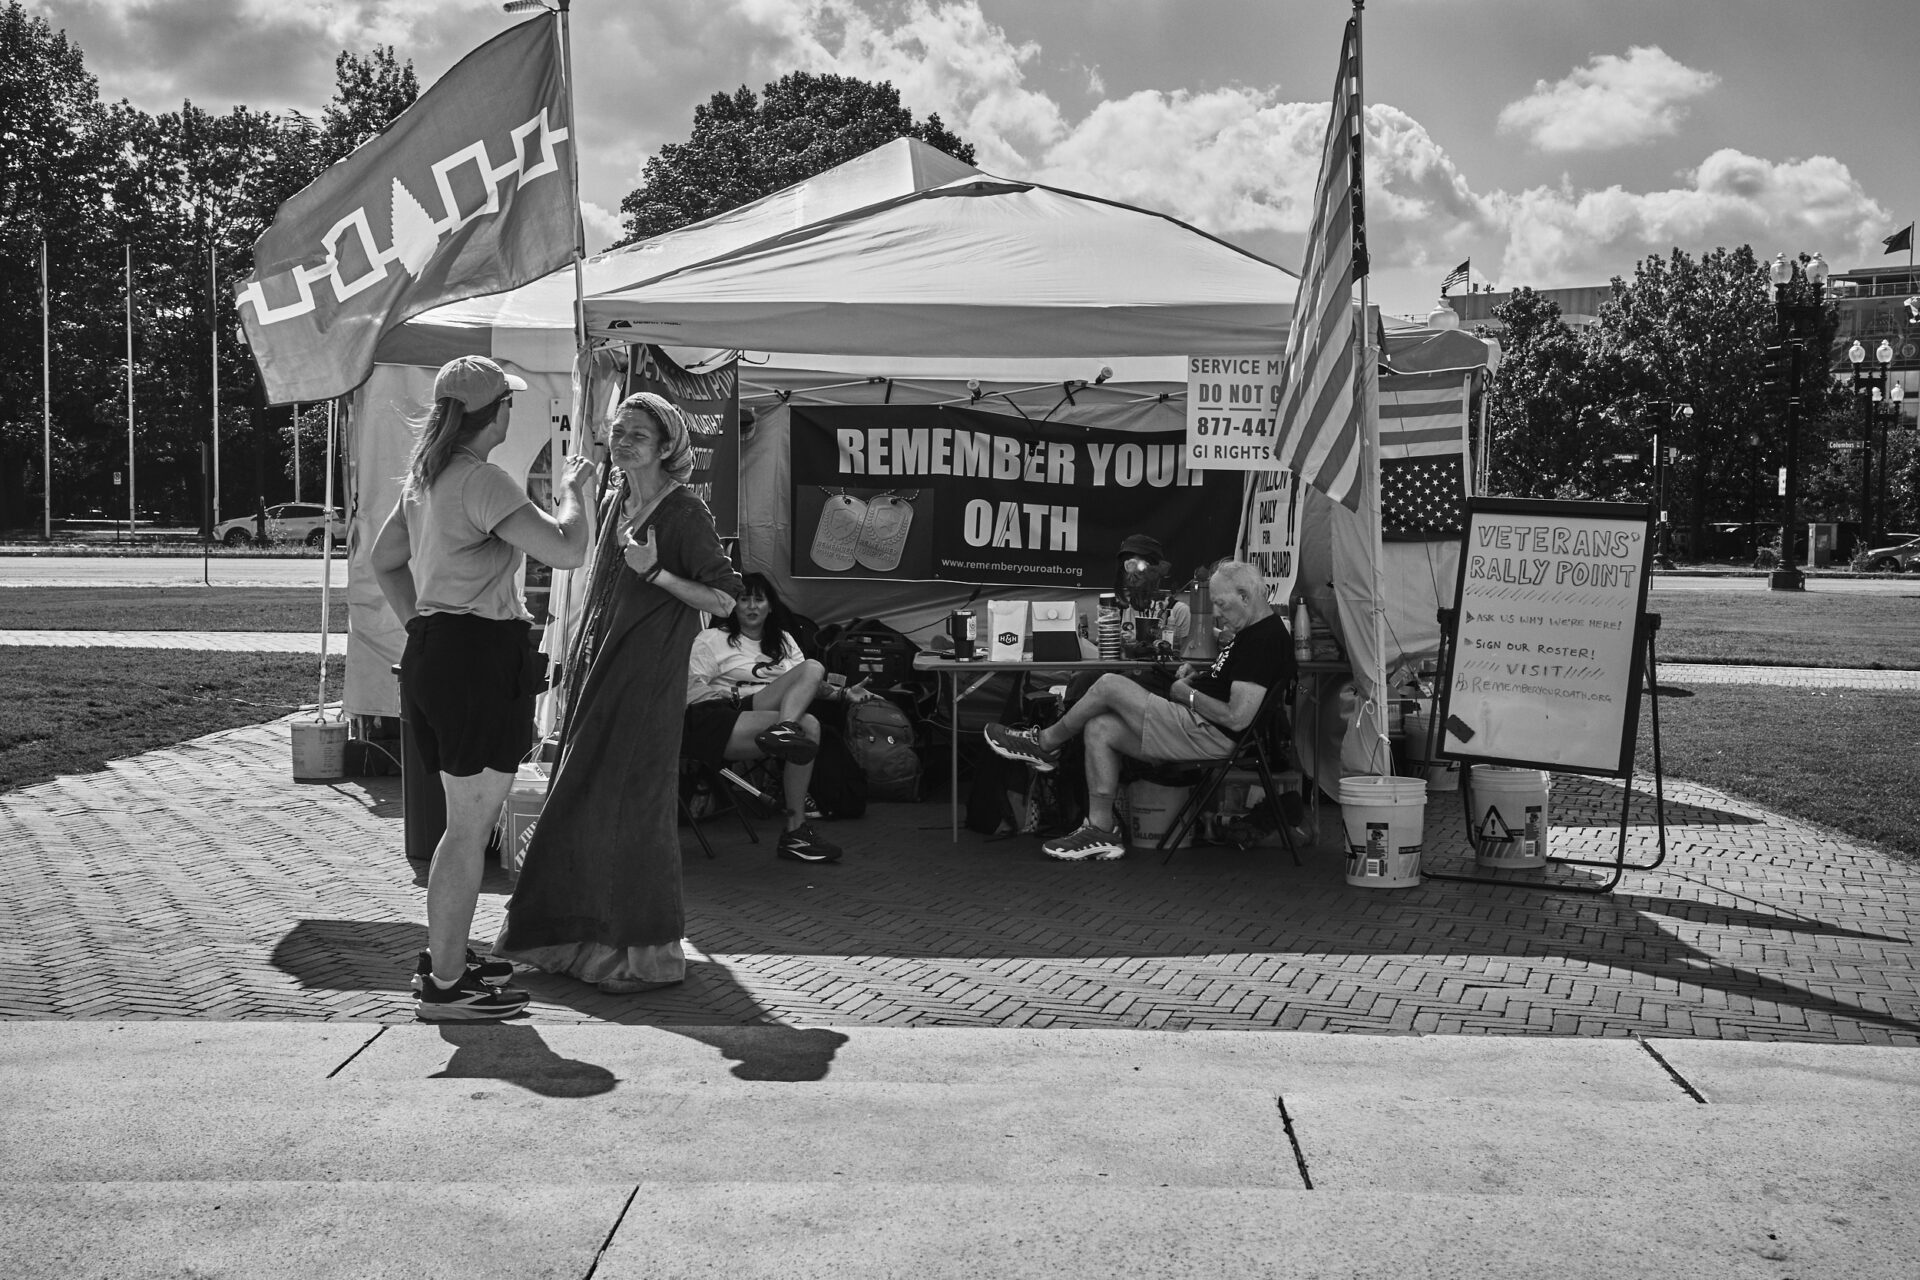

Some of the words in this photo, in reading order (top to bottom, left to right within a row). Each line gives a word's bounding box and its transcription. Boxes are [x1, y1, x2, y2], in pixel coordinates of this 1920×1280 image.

[1191, 358, 1260, 375] SERVICE
[1199, 383, 1222, 403] DO
[1229, 384, 1264, 404] NOT
[837, 427, 1075, 485] REMEMBER
[1192, 444, 1208, 459] GI
[1214, 445, 1270, 460] RIGHTS
[1259, 500, 1277, 525] DAILY
[964, 499, 1079, 553] OATH
[1263, 530, 1271, 545] FOR
[941, 558, 1083, 577] www.rememberyouroath.org
[1272, 551, 1291, 578] GUARD
[1470, 555, 1549, 585] RALLY
[1556, 561, 1636, 588] POINT
[1476, 613, 1495, 622] ASK
[1500, 614, 1514, 623] US
[1520, 616, 1543, 626] WHY
[1507, 643, 1530, 652] OUR
[1538, 644, 1595, 660] ROSTER!
[1506, 663, 1564, 677] VISIT
